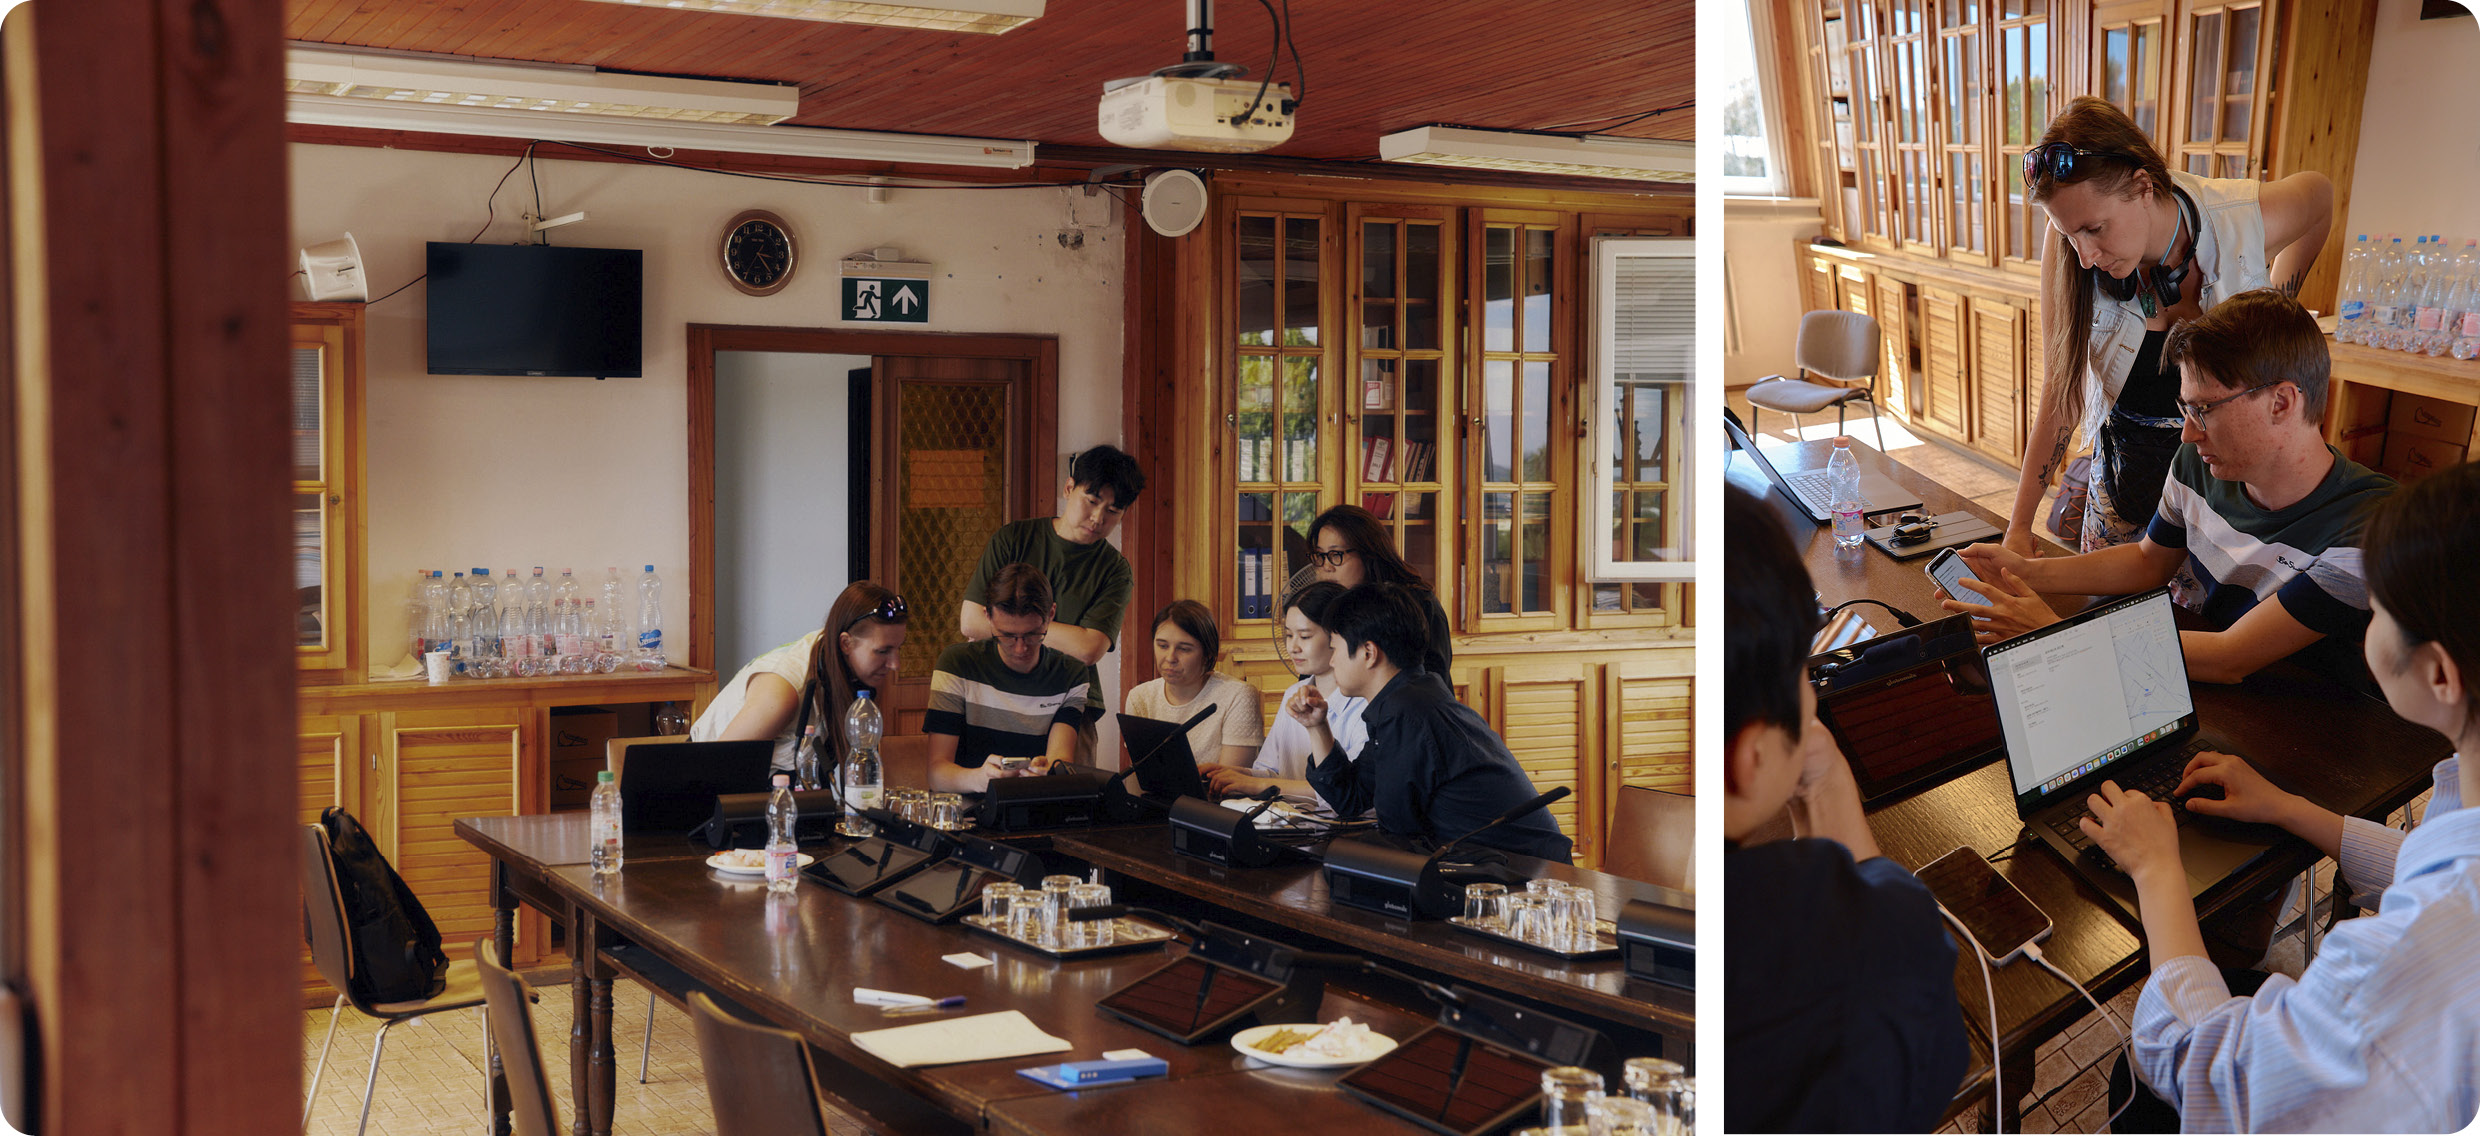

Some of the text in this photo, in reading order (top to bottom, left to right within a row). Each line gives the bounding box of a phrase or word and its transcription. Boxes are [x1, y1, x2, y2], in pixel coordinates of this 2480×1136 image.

[743, 226, 750, 234] 11
[755, 224, 764, 232] 12
[734, 235, 742, 243] 10
[775, 238, 781, 246] 2
[731, 248, 737, 256] 9
[779, 250, 785, 259] 3
[734, 261, 740, 269] 8
[774, 263, 781, 271] 4
[743, 271, 749, 280] 7
[754, 274, 760, 284] 6
[765, 271, 773, 281] 5
